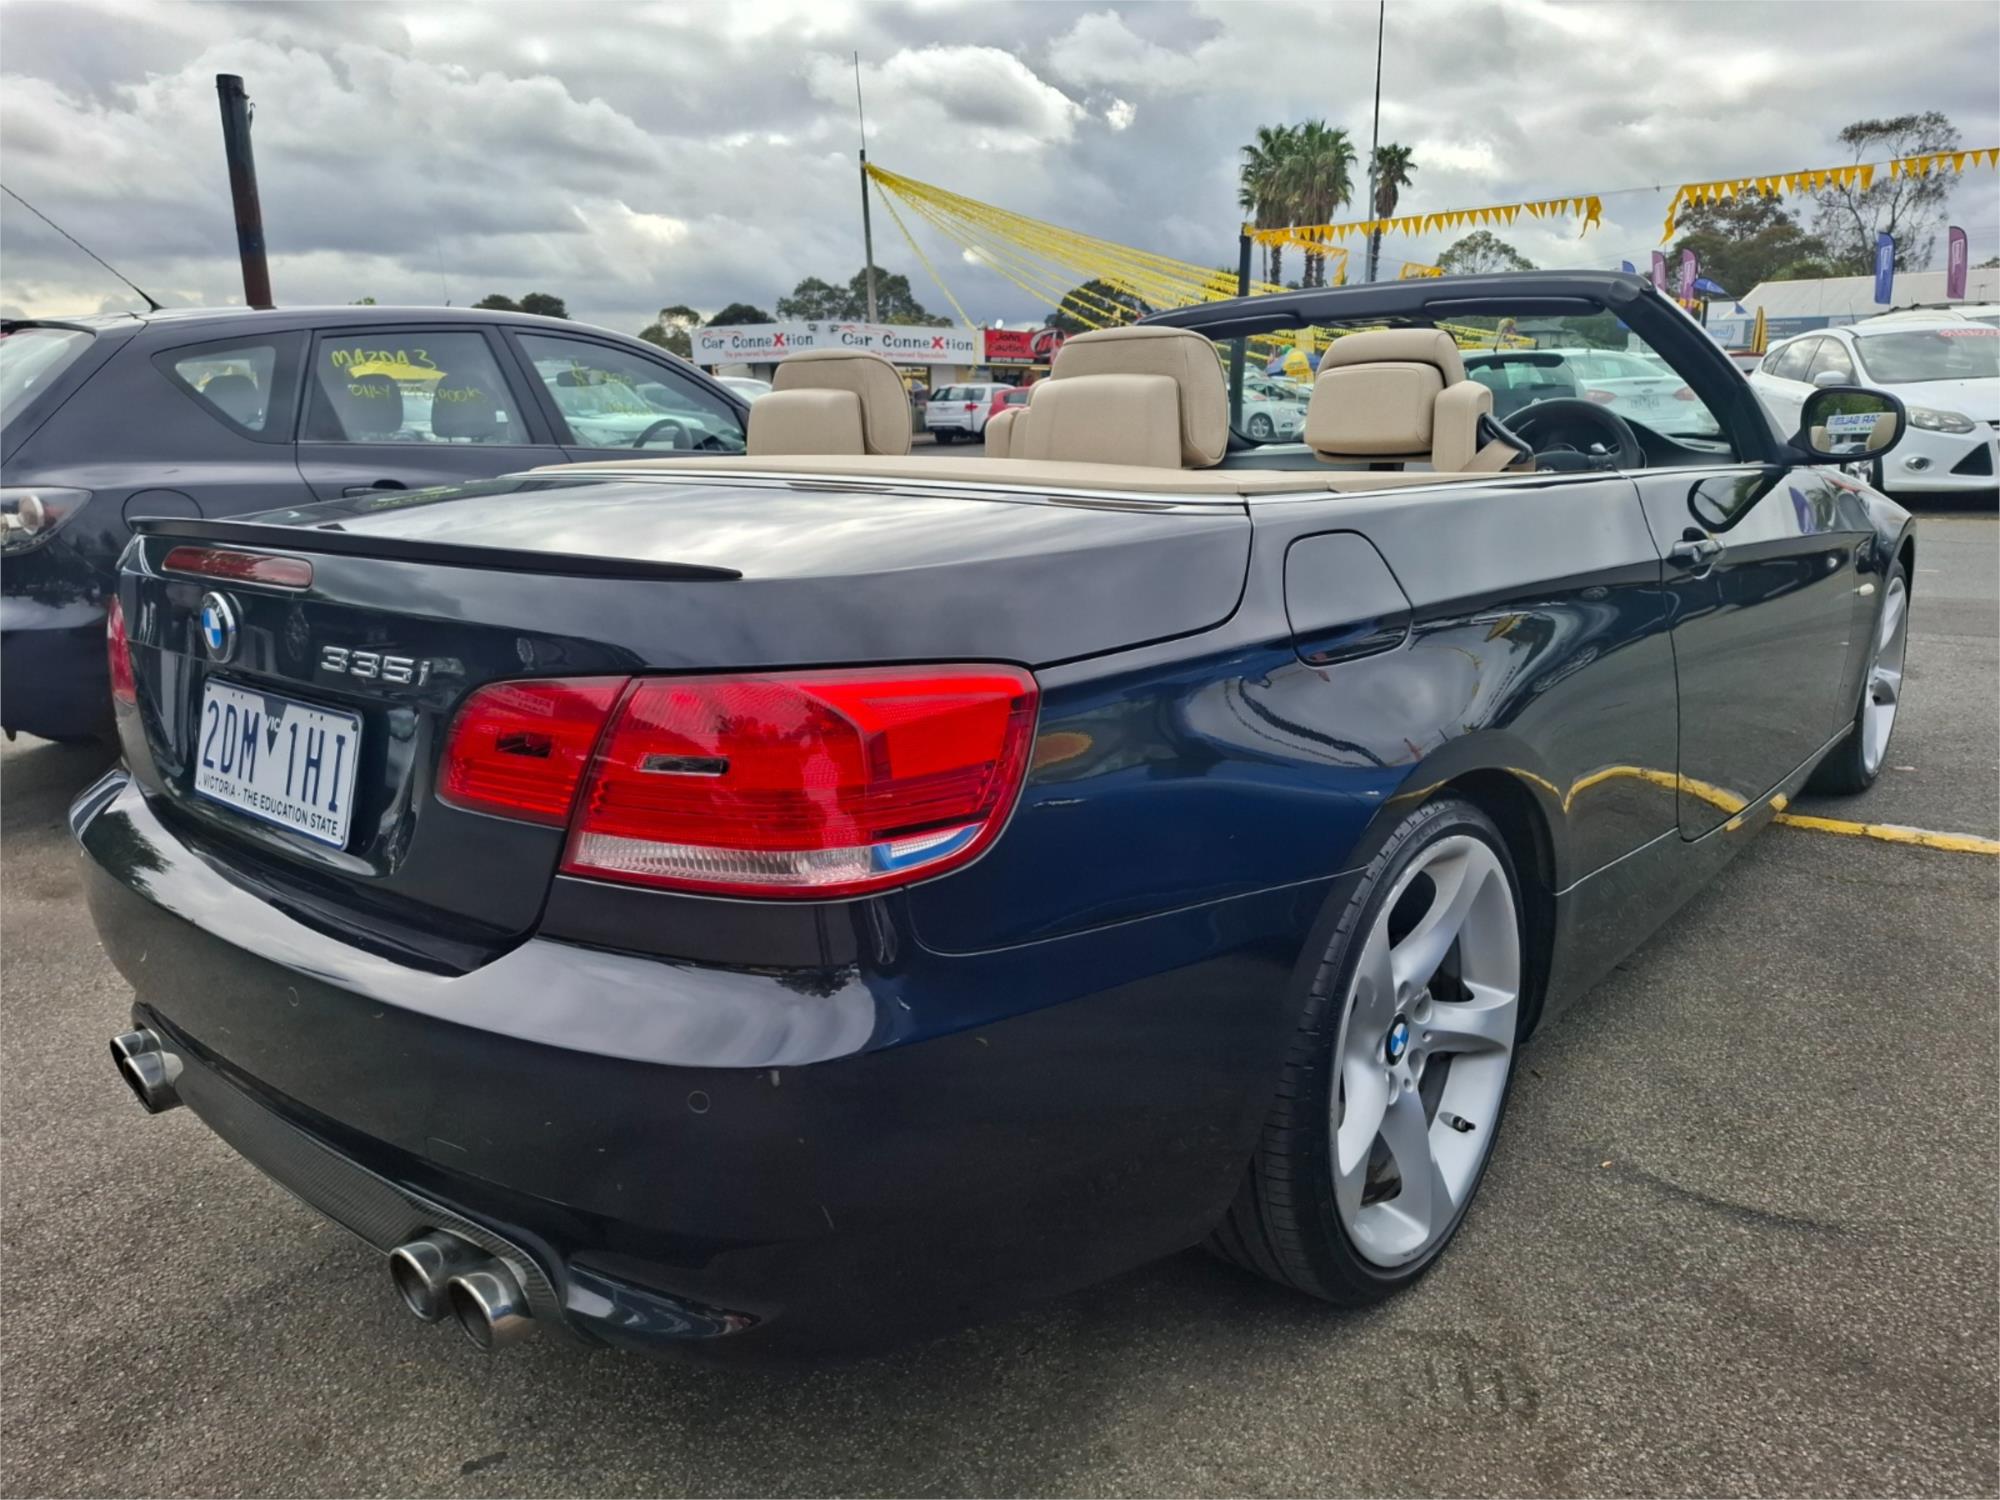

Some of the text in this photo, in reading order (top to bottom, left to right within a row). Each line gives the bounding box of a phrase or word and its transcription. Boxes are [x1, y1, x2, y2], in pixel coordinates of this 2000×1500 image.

[702, 333, 814, 350] Car ConneXtion
[841, 332, 973, 351] Car ConneXtion
[332, 348, 437, 370] MAZDA 3
[320, 645, 431, 686] 335i
[266, 715, 281, 733] VIC
[202, 699, 346, 813] 2DM 1HI
[203, 773, 236, 797] VICTORIA
[243, 788, 258, 806] THE
[260, 795, 308, 825] EDUCATION
[310, 813, 339, 836] STATE
